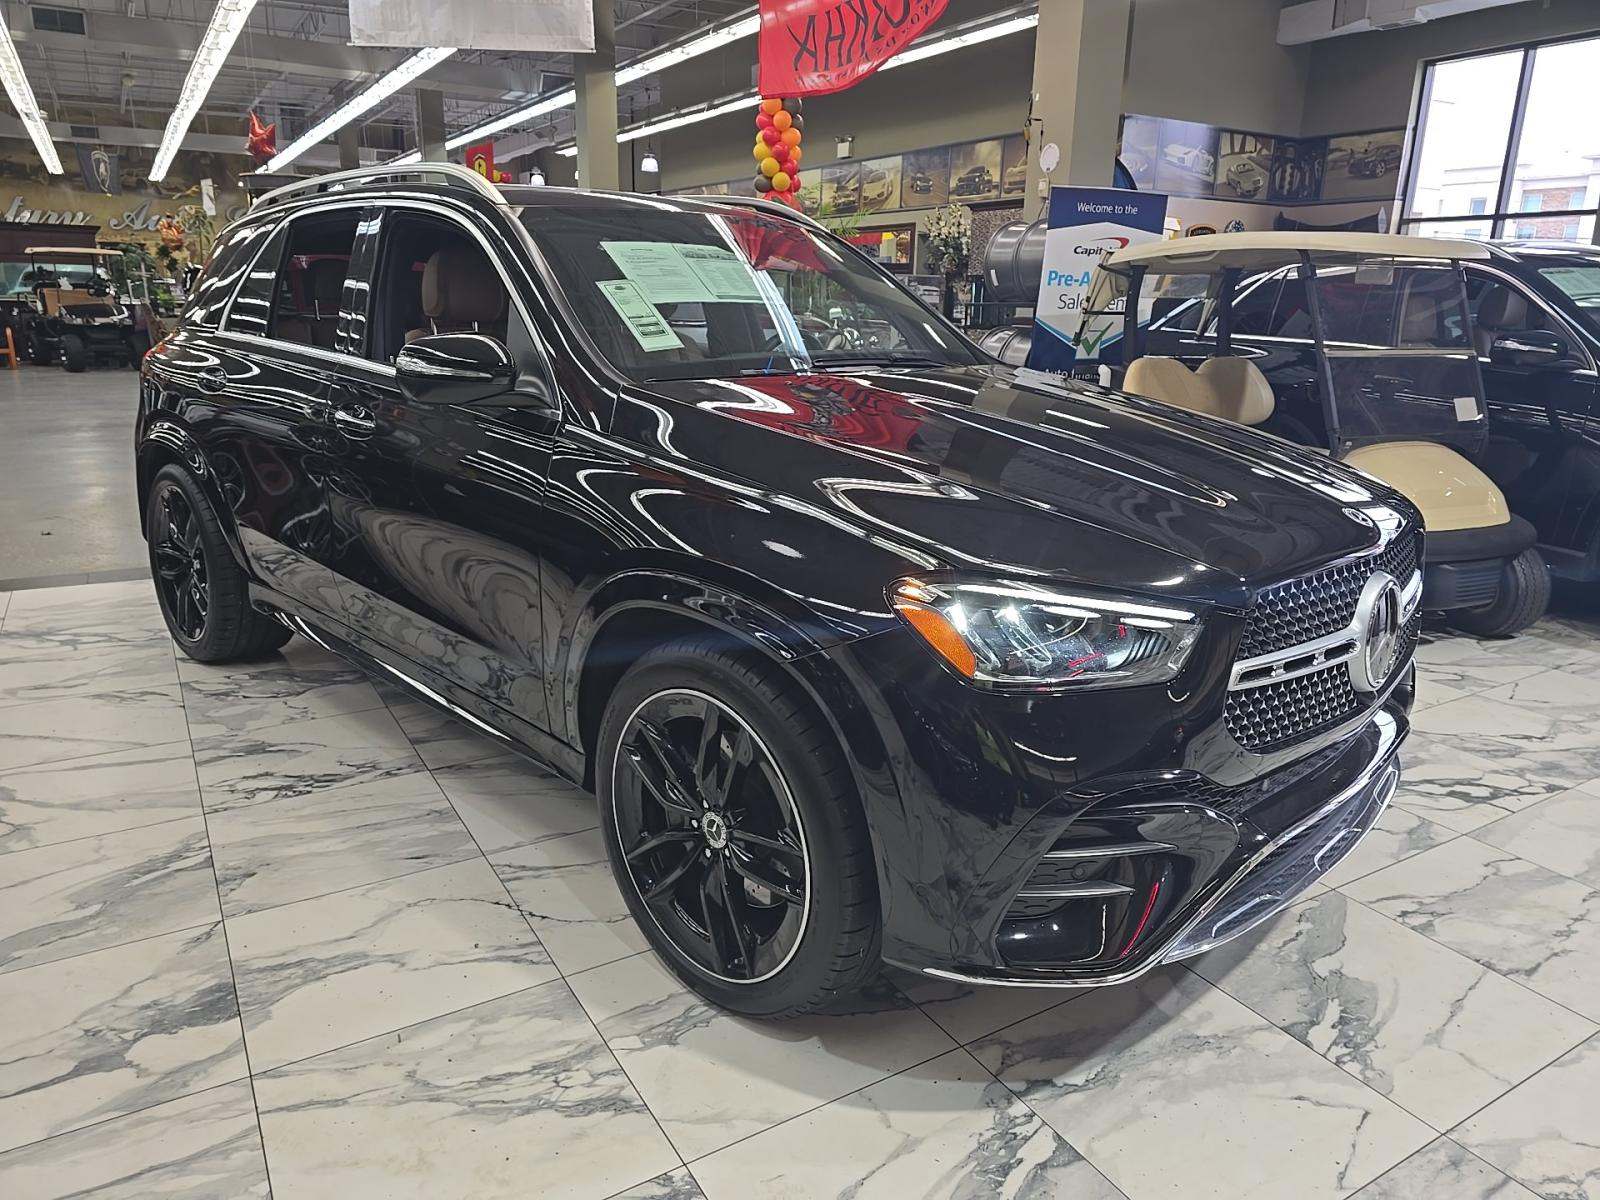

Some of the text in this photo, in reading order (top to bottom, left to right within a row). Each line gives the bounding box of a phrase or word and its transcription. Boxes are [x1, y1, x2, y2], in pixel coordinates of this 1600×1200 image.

[1077, 201, 1139, 216] Welcome to the
[1073, 245, 1103, 257] Capit
